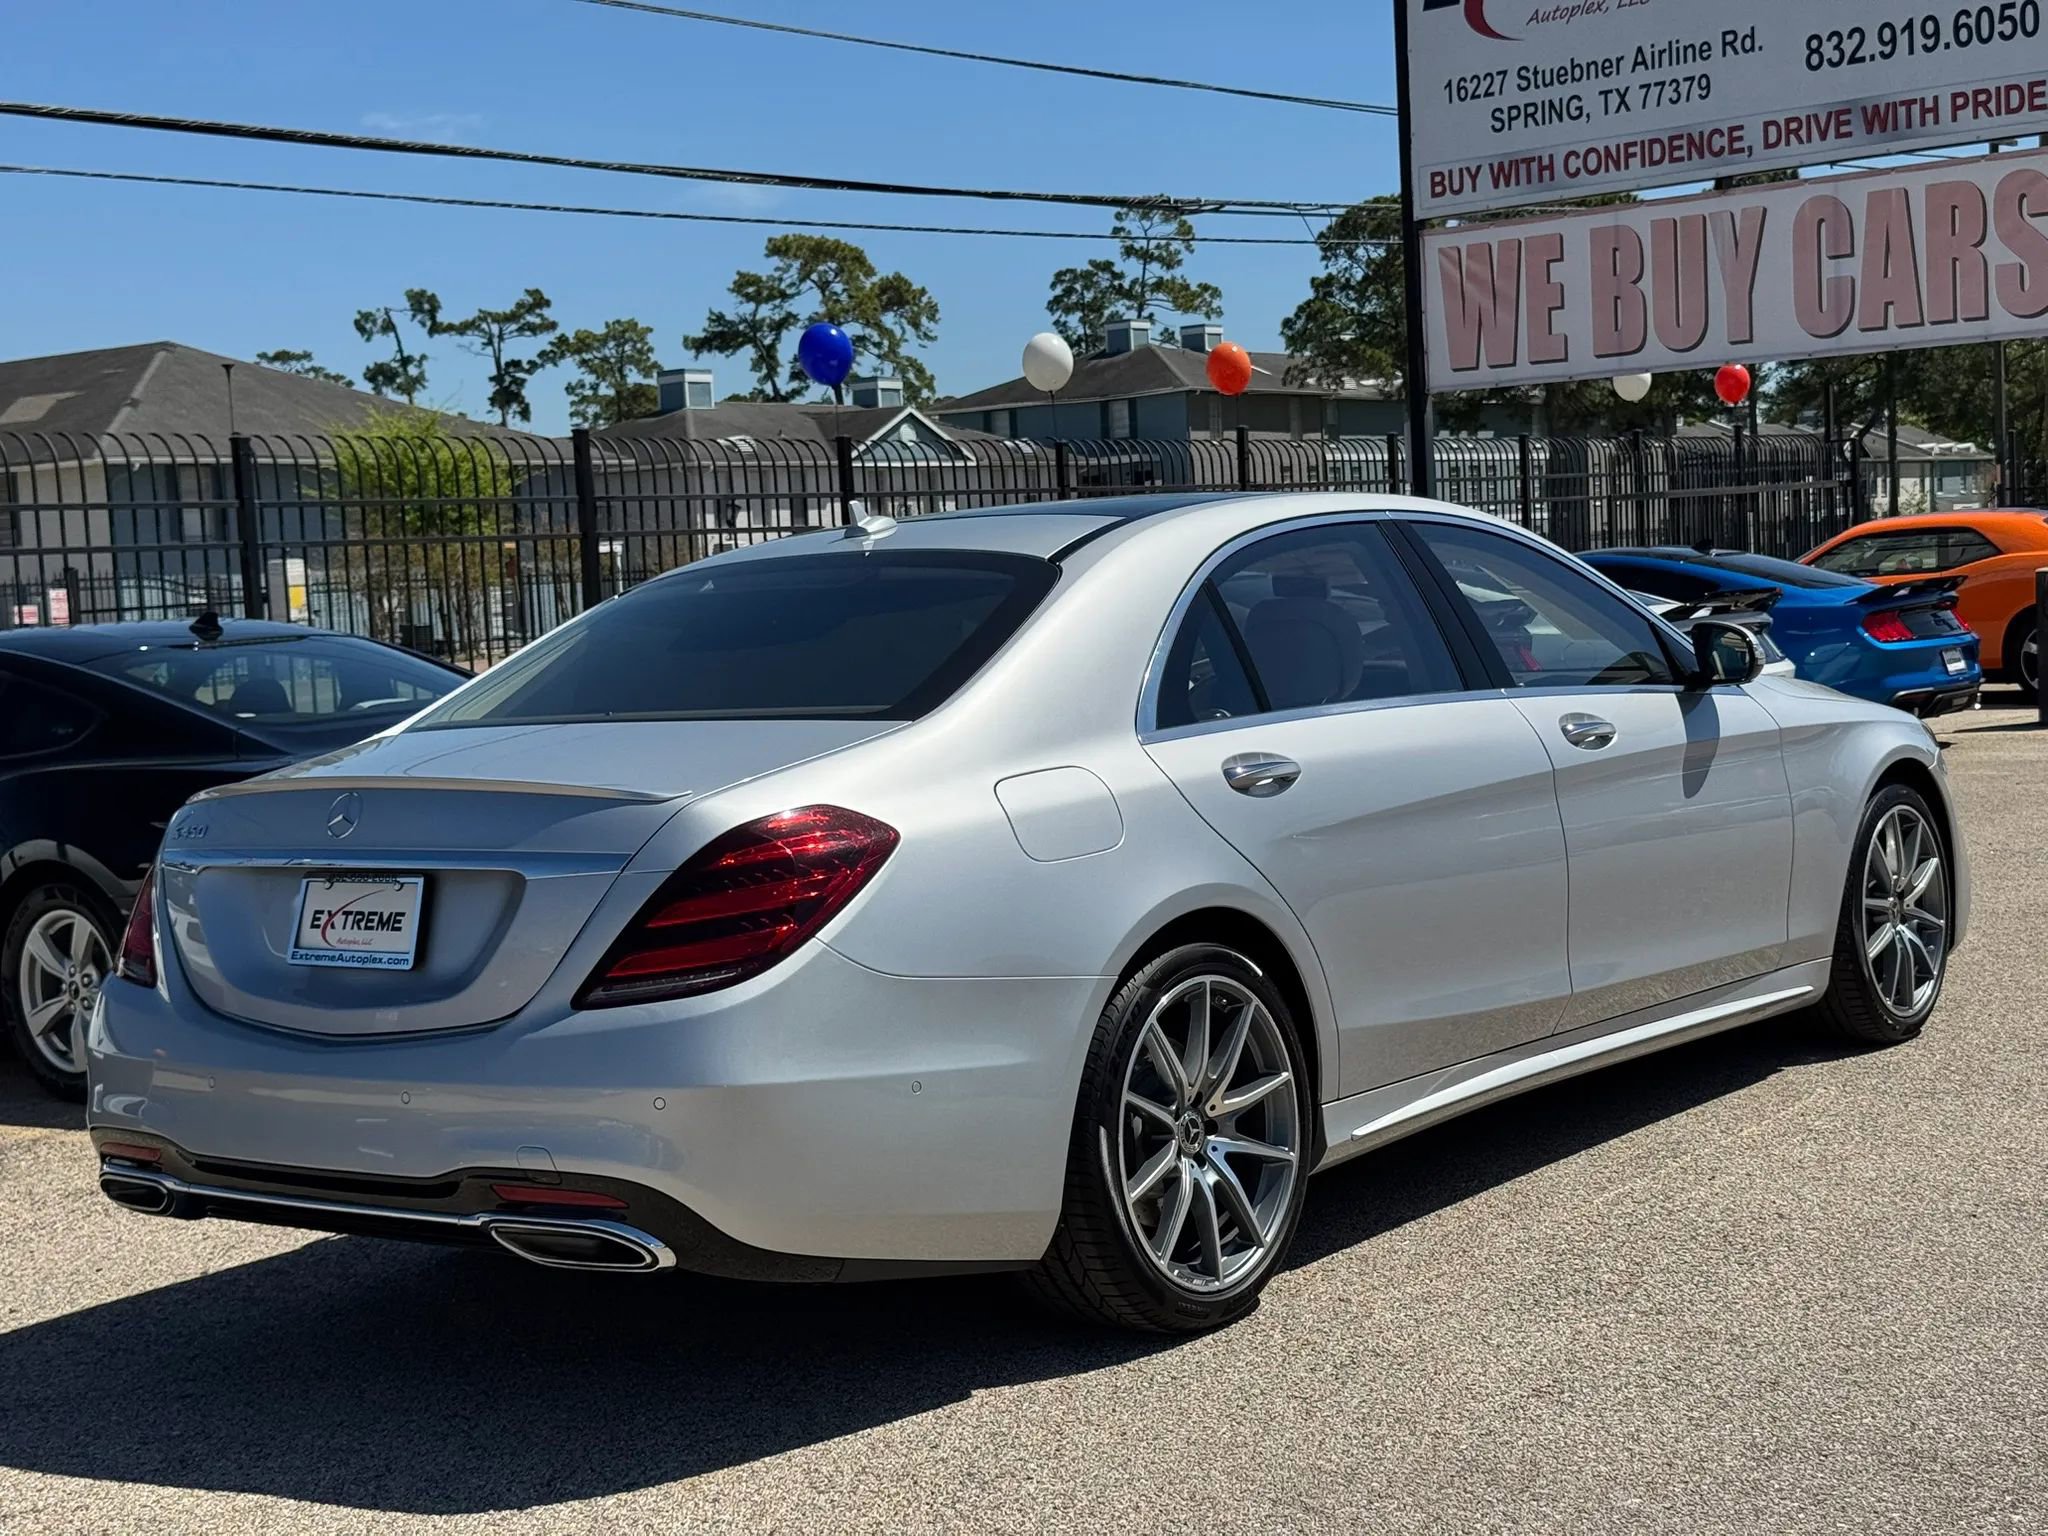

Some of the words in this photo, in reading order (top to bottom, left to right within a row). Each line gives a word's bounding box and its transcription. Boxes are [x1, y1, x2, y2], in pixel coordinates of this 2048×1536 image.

[1526, 0, 1609, 25] Autoplex,
[1806, 0, 2040, 72] 832.919.6050
[1444, 70, 1508, 104] 16227
[1516, 56, 1625, 93] Stuebner
[1631, 39, 1713, 73] Airline
[1722, 26, 1764, 57] Rd.
[1490, 95, 1591, 134] SPRING,
[1598, 86, 1632, 115] TX
[1638, 74, 1712, 109] 77379
[1430, 164, 1483, 198] BUY
[1489, 154, 1555, 190] WITH
[1563, 124, 1755, 179] CONFIDENCE,
[1763, 108, 1853, 149] DRIVE
[1861, 96, 1940, 134] WITH
[1950, 79, 2048, 122] PRIDE
[1438, 233, 1568, 372] WE
[1589, 206, 1767, 358] BUY
[1792, 169, 2048, 338] CARS
[310, 909, 406, 932] EXTREME
[291, 950, 410, 965] ExtremeAutoplex.com
